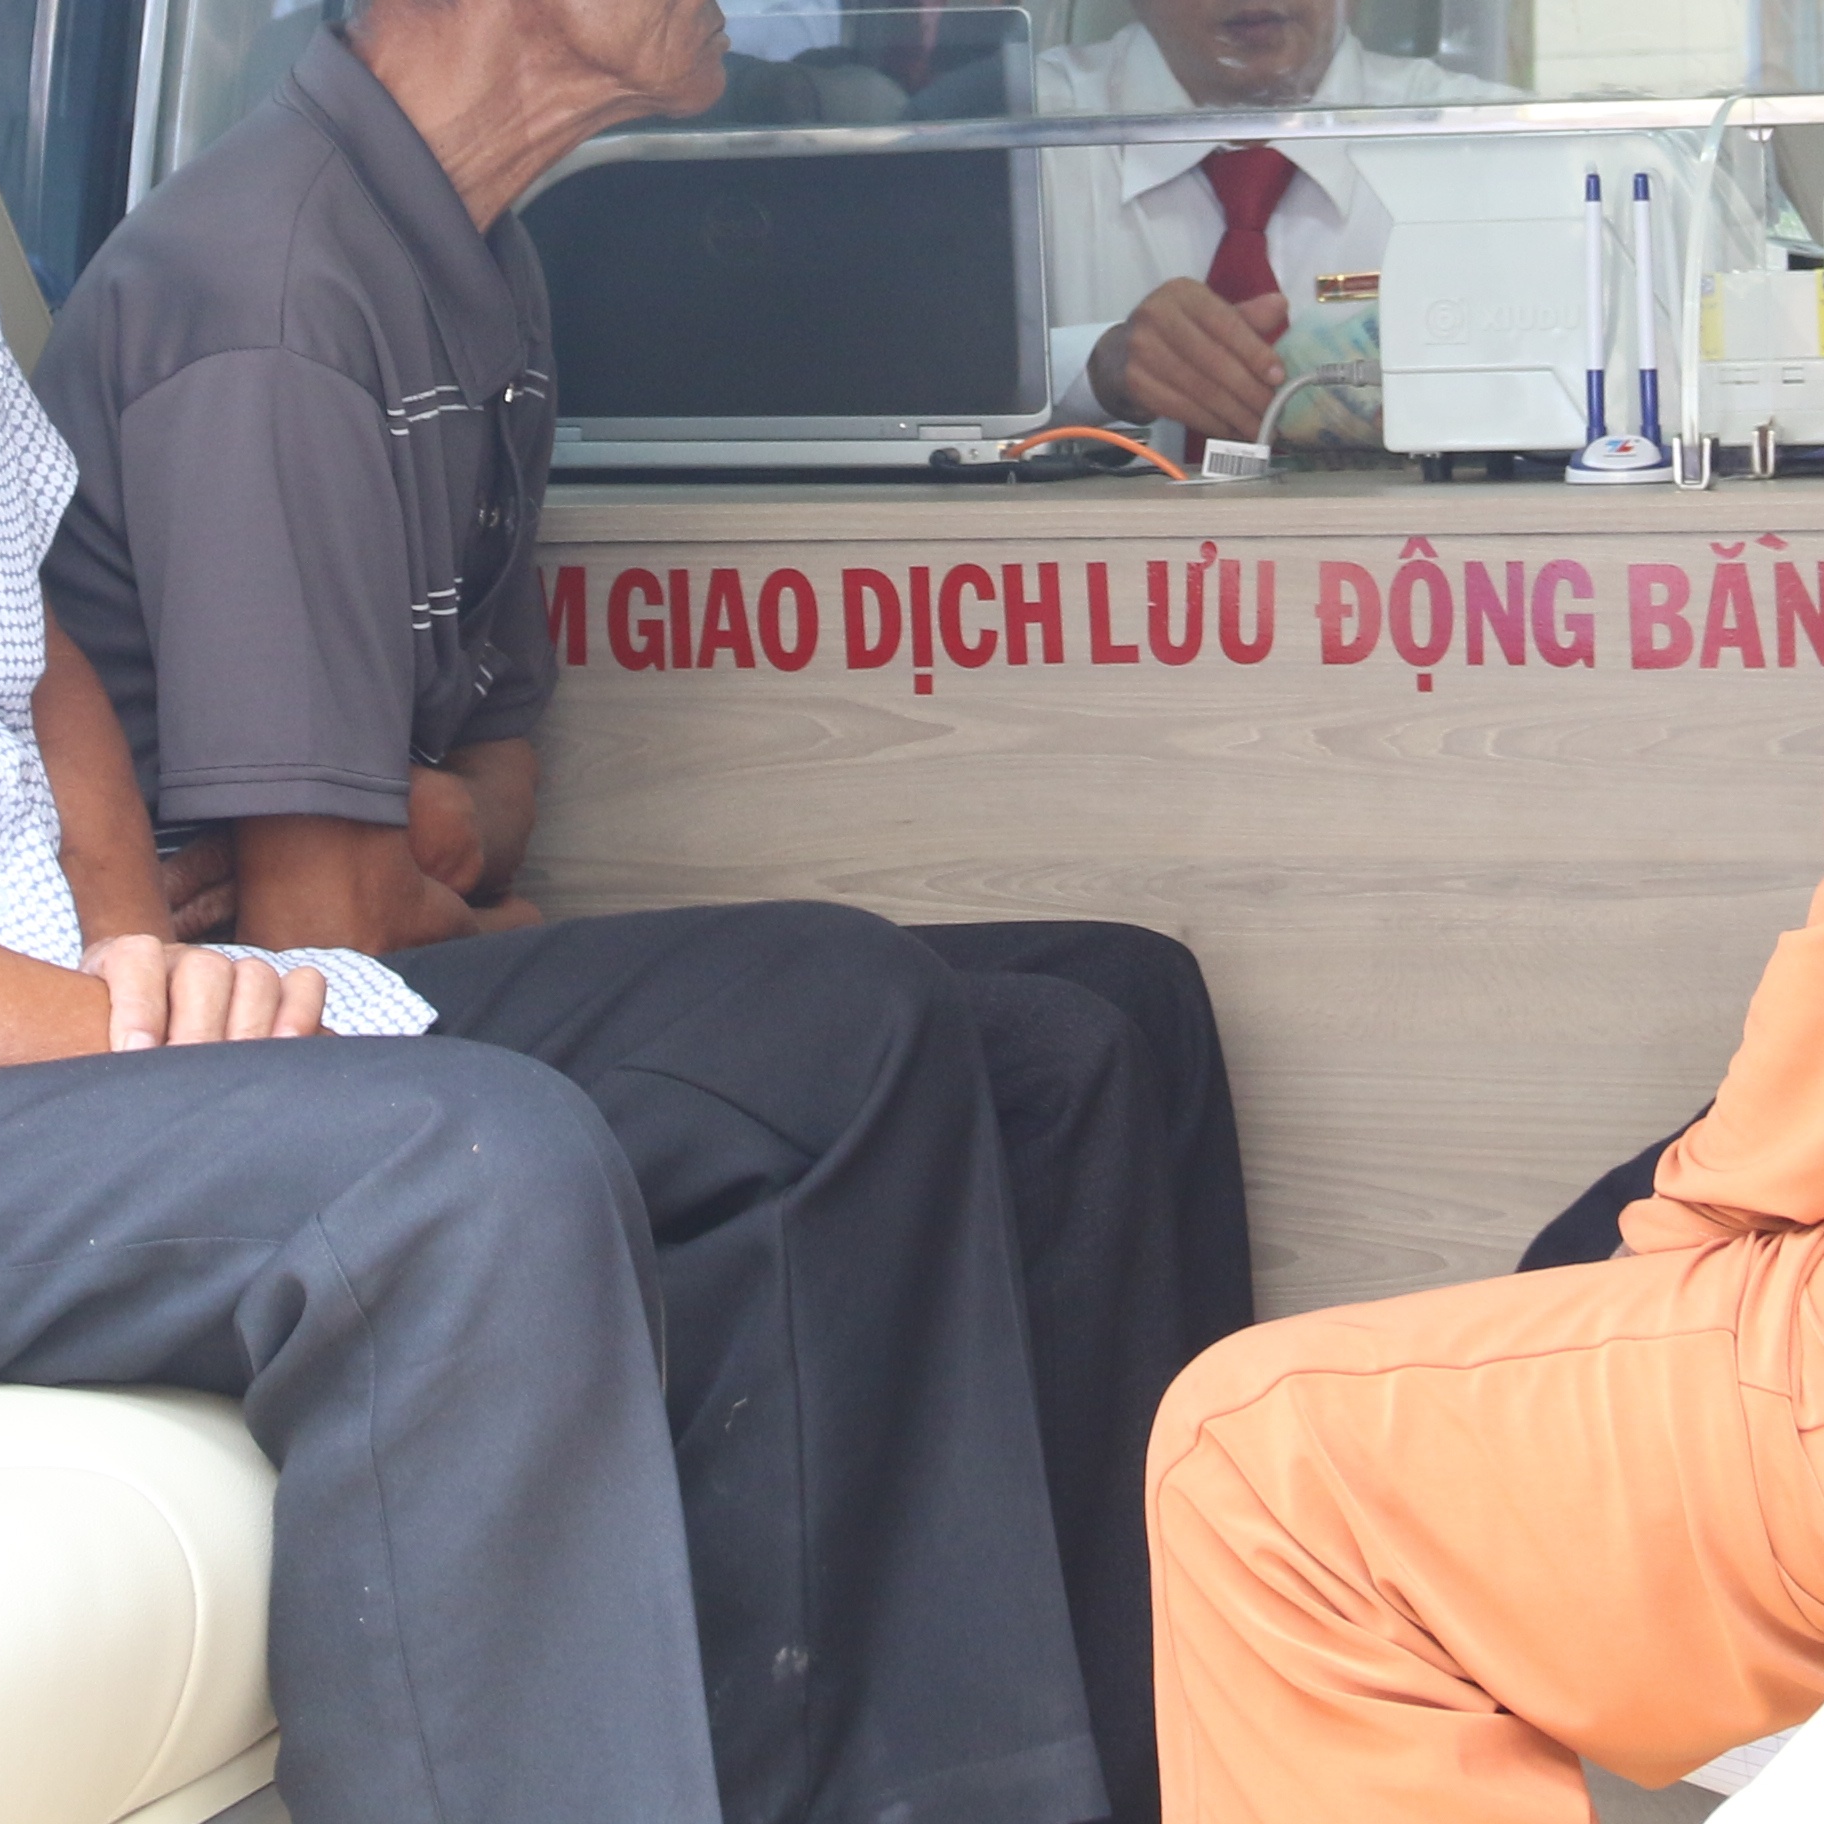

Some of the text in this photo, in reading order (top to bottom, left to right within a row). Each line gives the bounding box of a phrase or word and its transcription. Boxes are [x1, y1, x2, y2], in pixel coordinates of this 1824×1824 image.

[607, 566, 821, 672] GIAO
[841, 561, 1067, 696] DỊCH
[1085, 540, 1277, 667] LƯU
[1314, 535, 1597, 694] ĐỘNG
